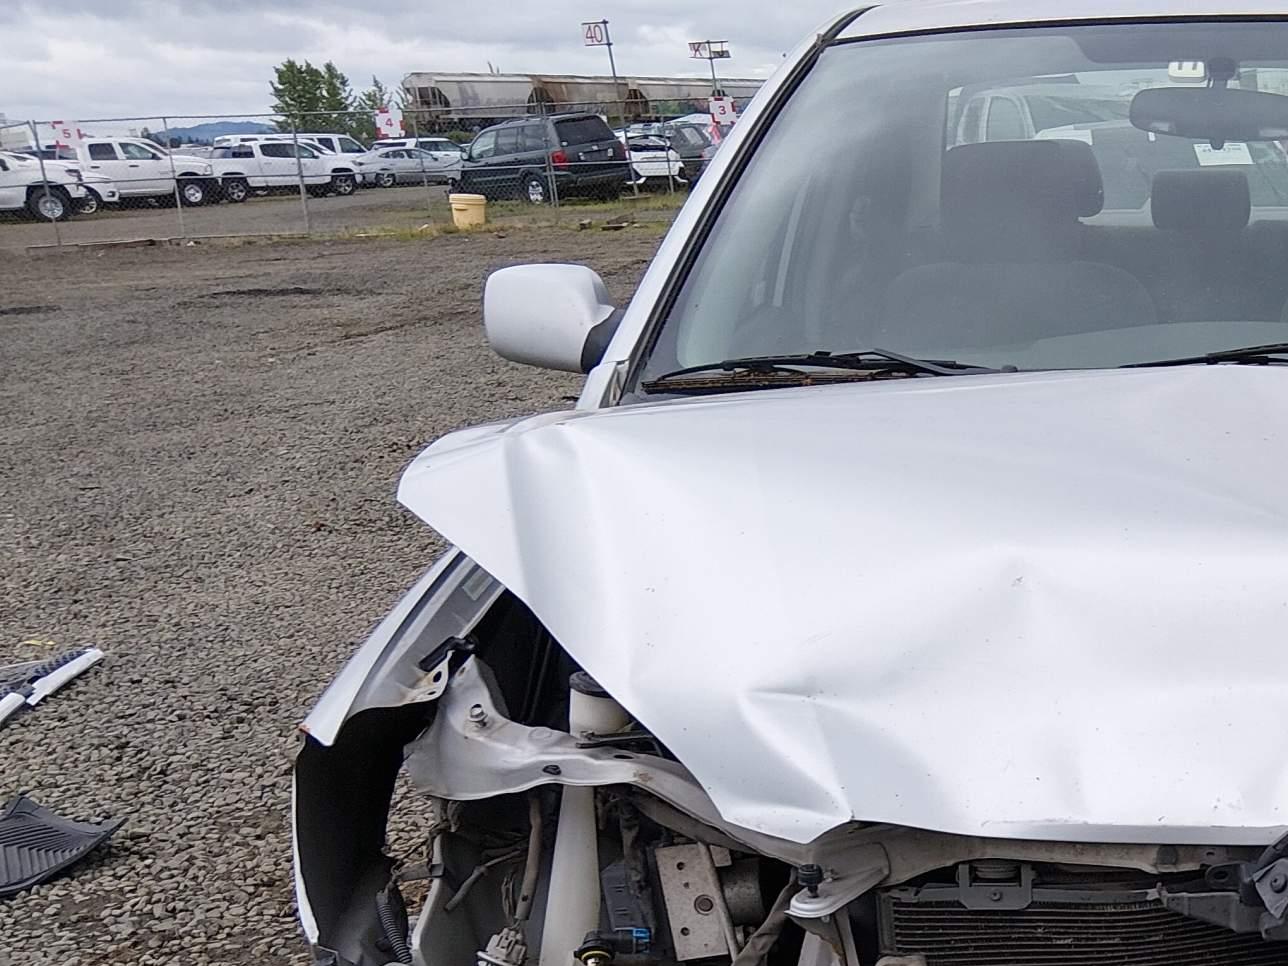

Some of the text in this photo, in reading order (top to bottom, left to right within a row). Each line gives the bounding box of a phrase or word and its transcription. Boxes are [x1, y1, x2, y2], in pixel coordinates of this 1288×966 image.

[585, 24, 603, 43] 40
[718, 105, 727, 115] 3
[385, 118, 394, 128] 4
[62, 128, 72, 139] 5
